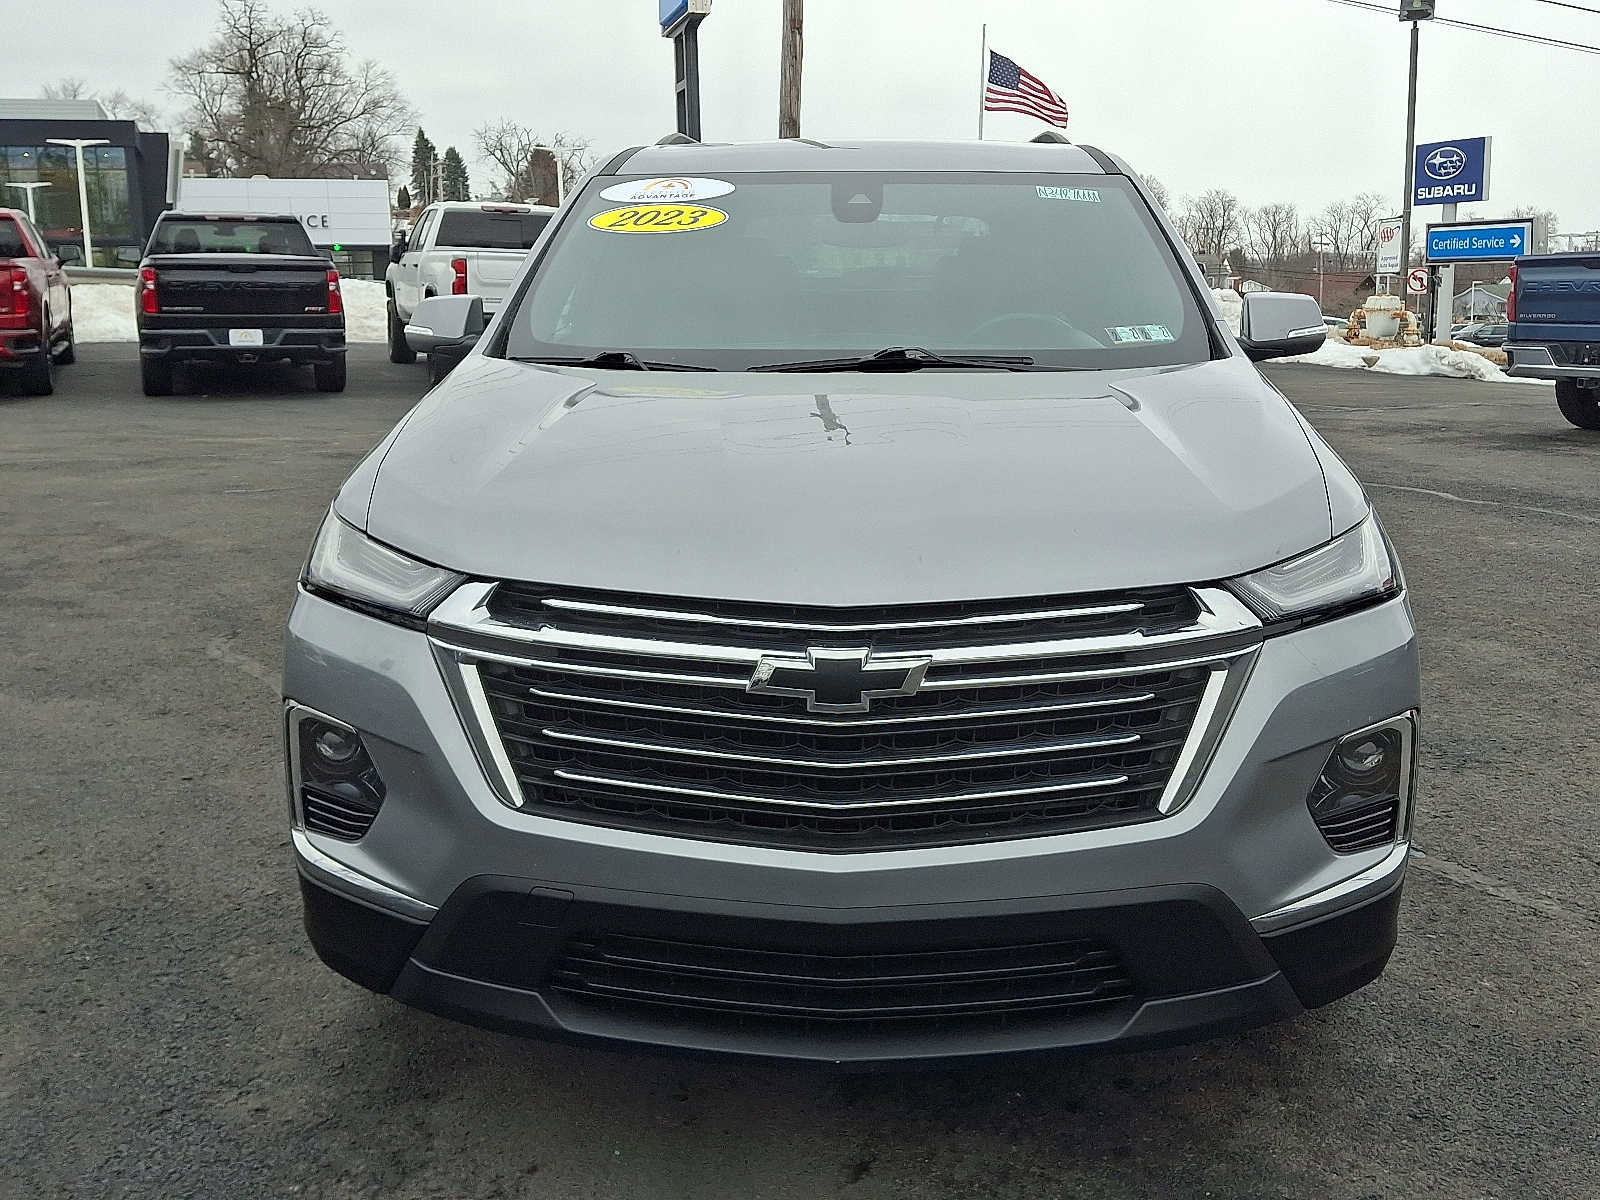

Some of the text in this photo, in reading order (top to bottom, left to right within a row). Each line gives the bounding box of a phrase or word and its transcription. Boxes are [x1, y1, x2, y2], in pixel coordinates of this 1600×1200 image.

[629, 192, 697, 200] ADVANTAGE
[1417, 183, 1476, 200] SUBARU
[607, 209, 708, 228] 2023
[1432, 234, 1505, 250] Certified Service
